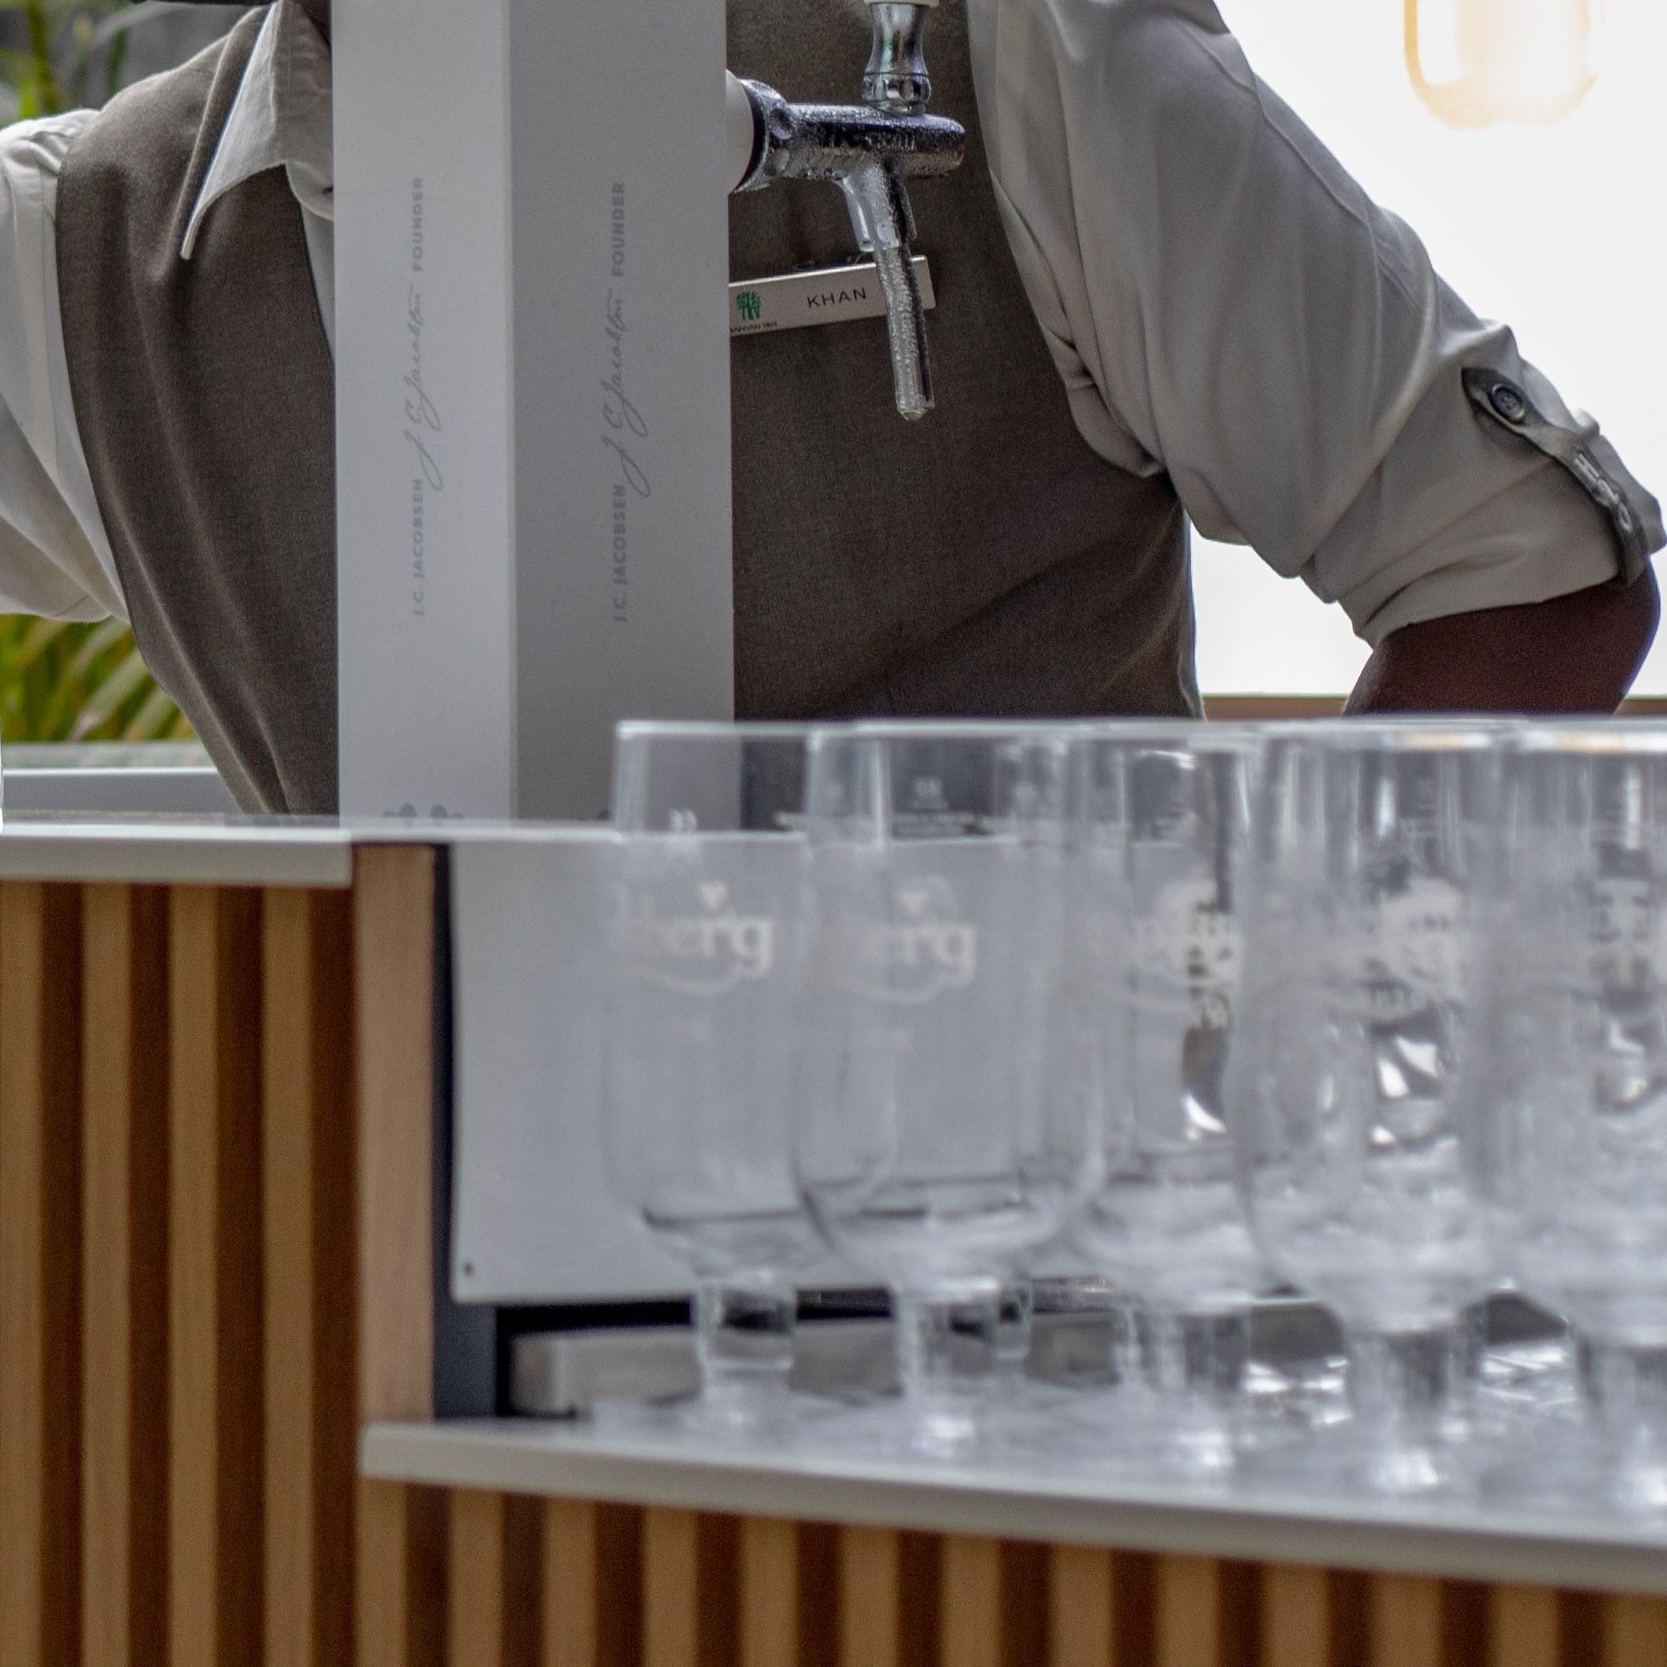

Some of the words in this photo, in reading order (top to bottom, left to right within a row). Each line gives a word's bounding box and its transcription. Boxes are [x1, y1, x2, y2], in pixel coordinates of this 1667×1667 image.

[412, 177, 423, 272] FOUNDER
[611, 183, 624, 277] FOUNDER
[807, 287, 867, 308] KHAN
[413, 479, 424, 579] JACOBSEN
[613, 485, 627, 585] JACOBSEN
